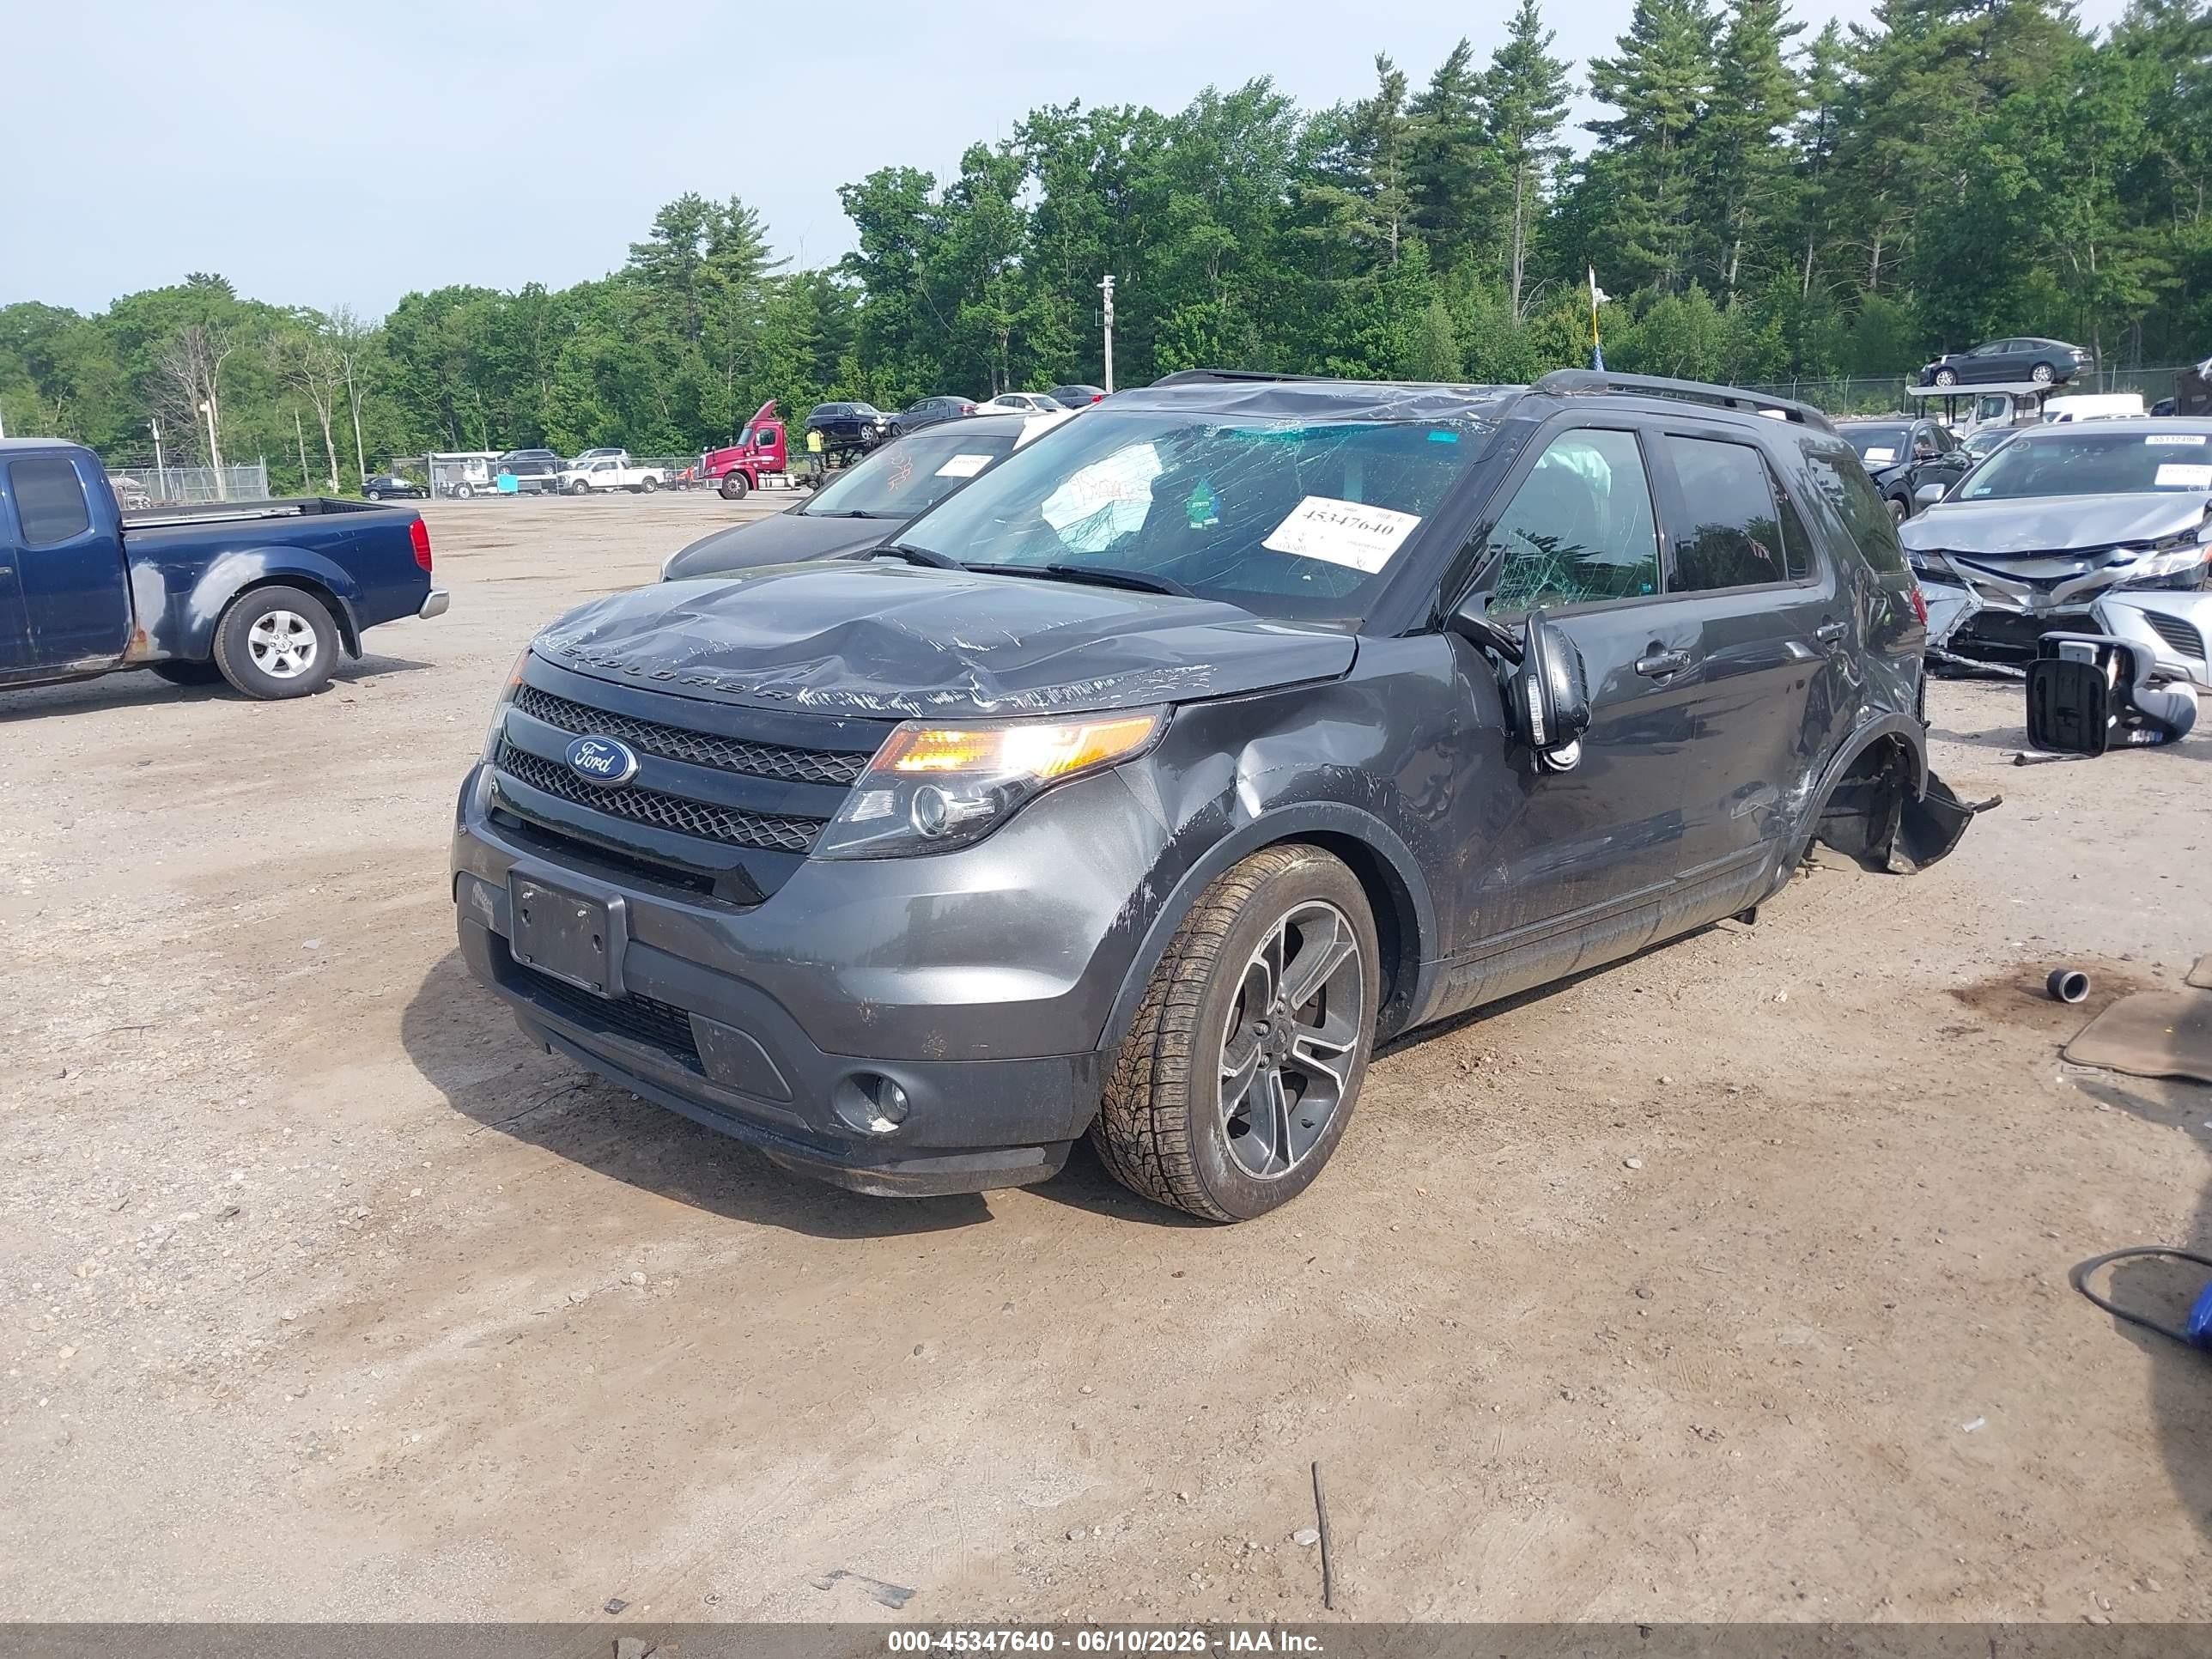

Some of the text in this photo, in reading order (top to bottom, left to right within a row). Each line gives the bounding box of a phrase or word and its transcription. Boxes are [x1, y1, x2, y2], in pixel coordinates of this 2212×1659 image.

[1302, 509, 1395, 536] 45347640
[559, 648, 793, 701] EXPLORER
[574, 741, 616, 773] Ford
